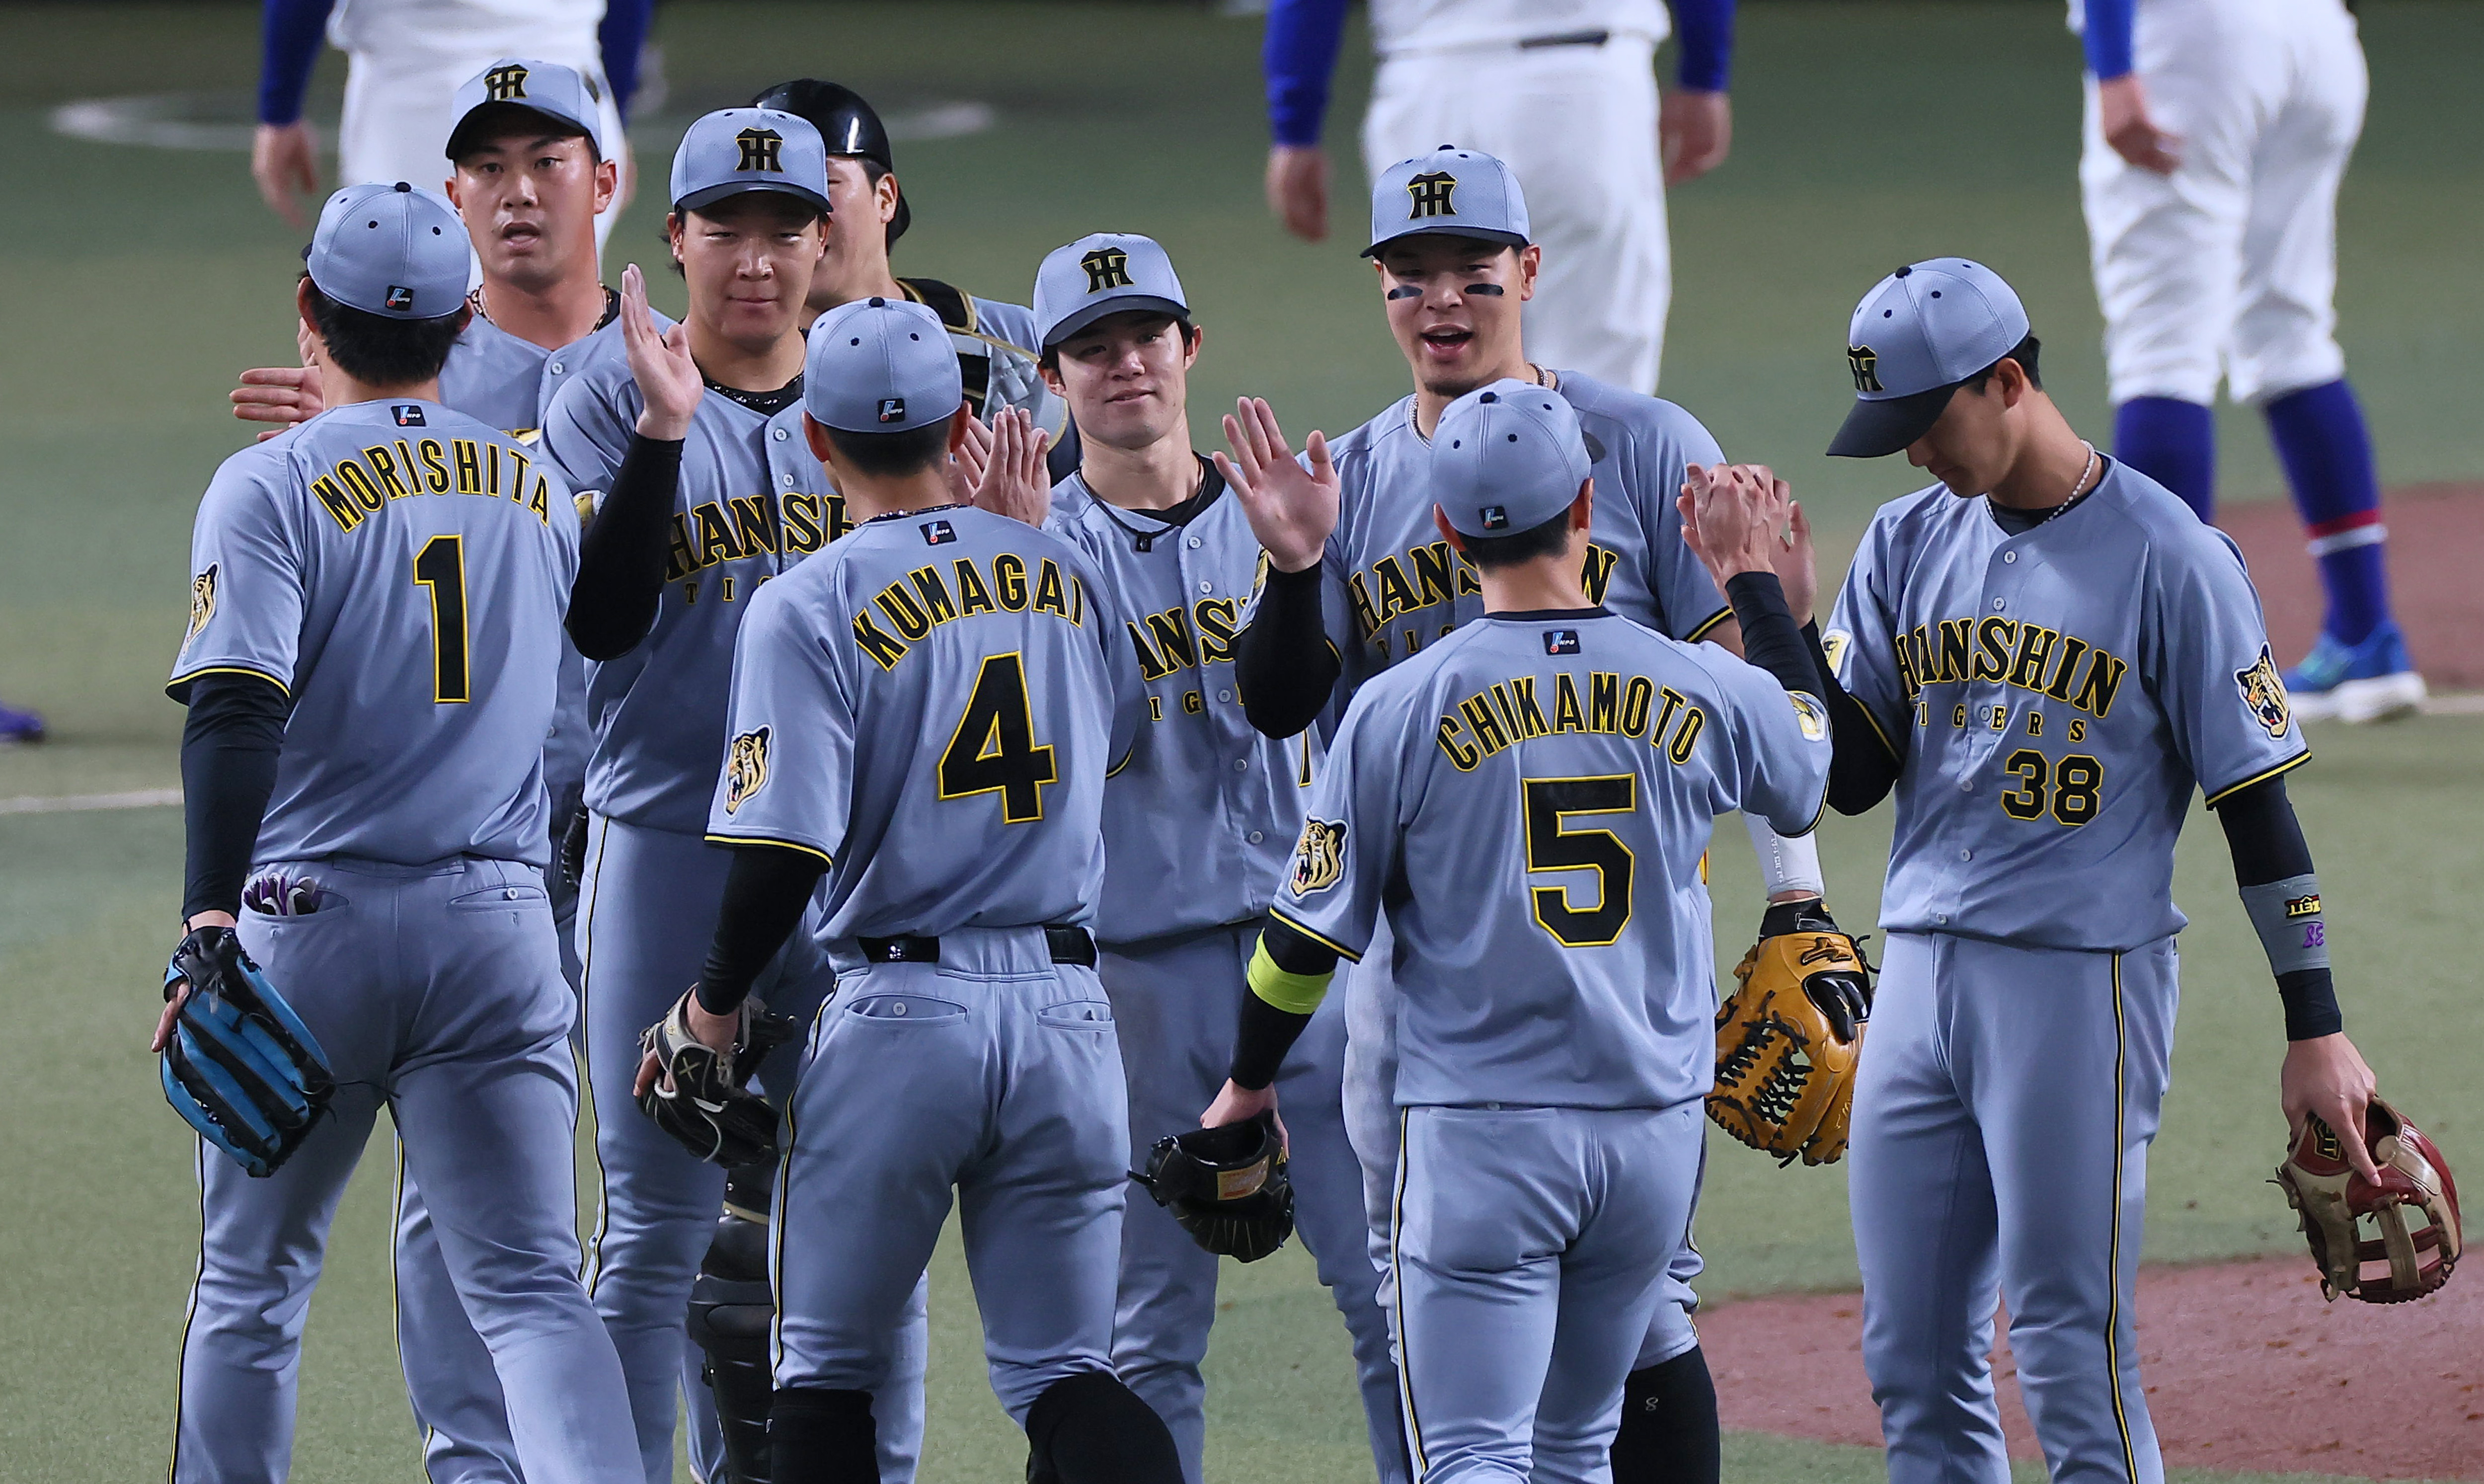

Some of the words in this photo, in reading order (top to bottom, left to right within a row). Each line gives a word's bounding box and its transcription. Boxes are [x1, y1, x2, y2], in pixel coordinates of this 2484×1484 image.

[310, 438, 549, 533] MORISHITA
[413, 534, 469, 703] 1
[852, 553, 1083, 672] KUMAGAI
[937, 651, 1058, 825] 4
[1437, 671, 1705, 772] CHIKAMOTO
[1914, 701, 2086, 742] IGERS
[2001, 748, 2103, 826] 38
[1522, 773, 1635, 947] 5
[2289, 899, 2321, 916] ZETT
